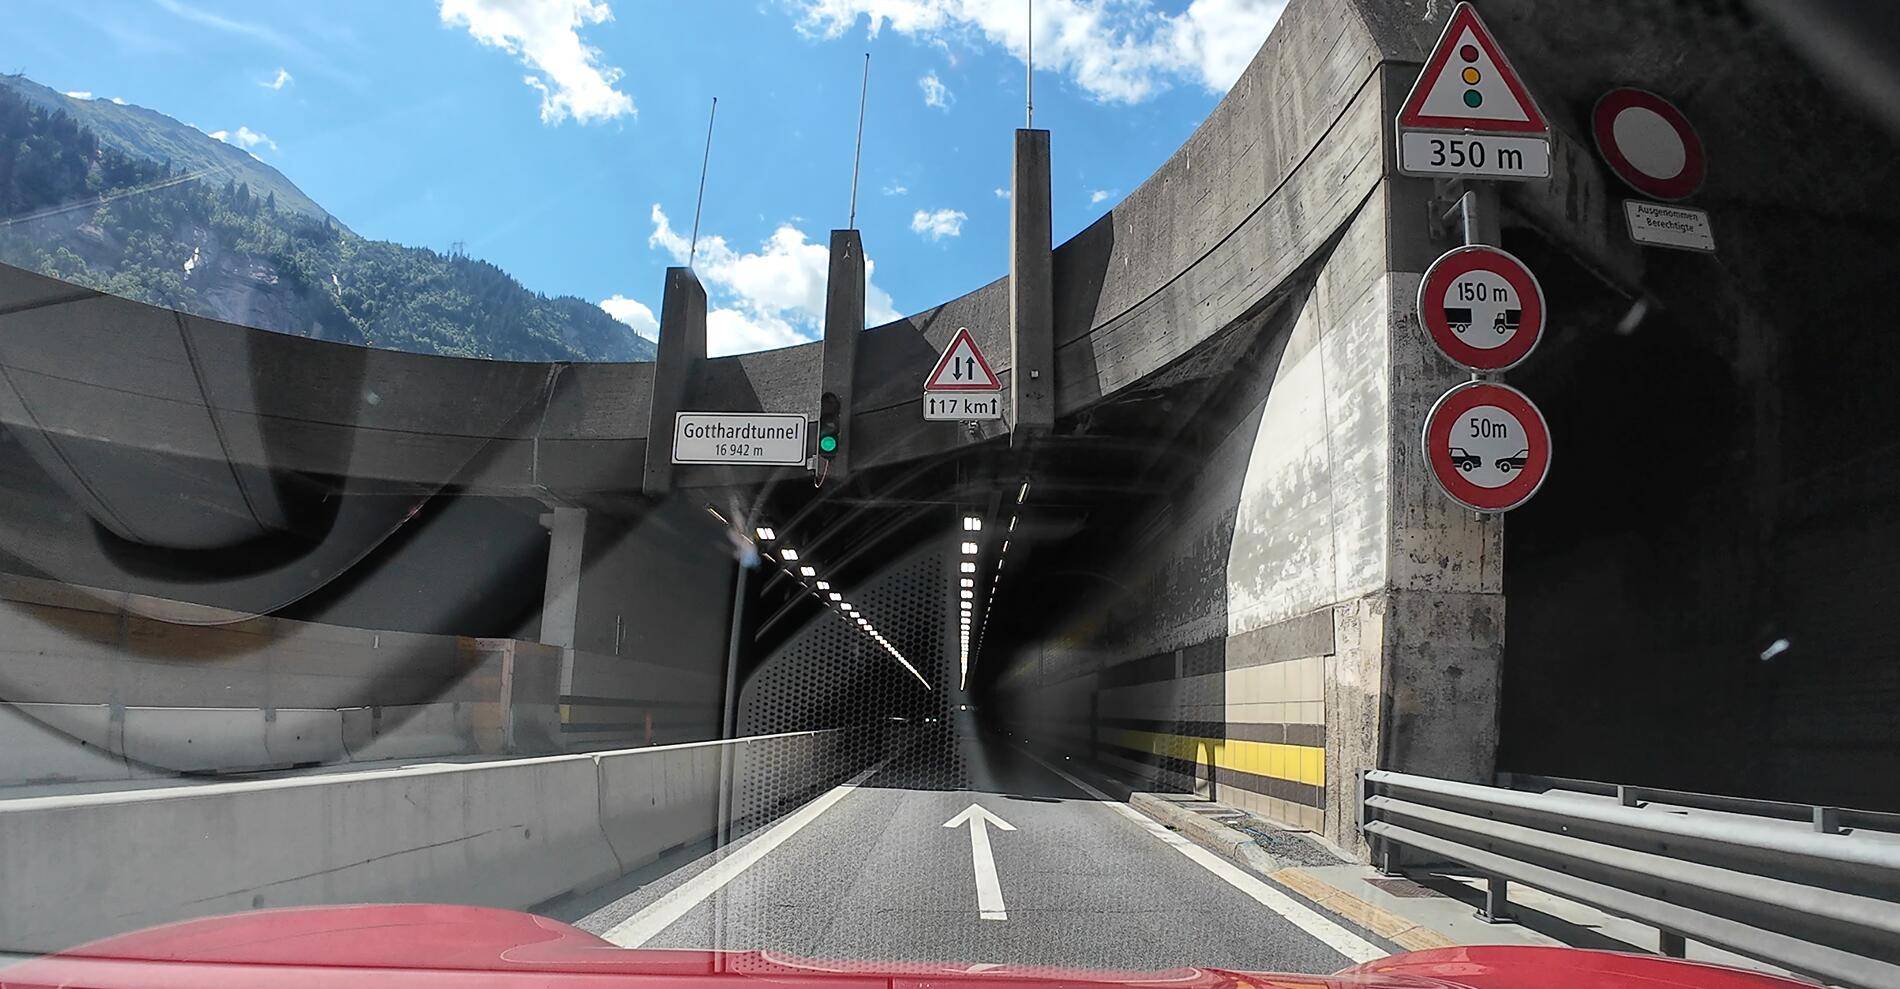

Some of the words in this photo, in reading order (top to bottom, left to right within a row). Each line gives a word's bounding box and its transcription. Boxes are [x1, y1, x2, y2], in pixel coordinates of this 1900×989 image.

[1430, 140, 1485, 167] 350
[1498, 148, 1522, 169] m
[1638, 205, 1699, 221] Ausgenommen
[1646, 217, 1694, 233] Berechtigte
[1458, 282, 1487, 301] 150
[1493, 288, 1507, 302] m
[939, 400, 957, 413] 17
[964, 399, 987, 413] km
[684, 423, 799, 439] Gotthardtunnel
[1470, 418, 1507, 438] 50m
[753, 447, 763, 456] m
